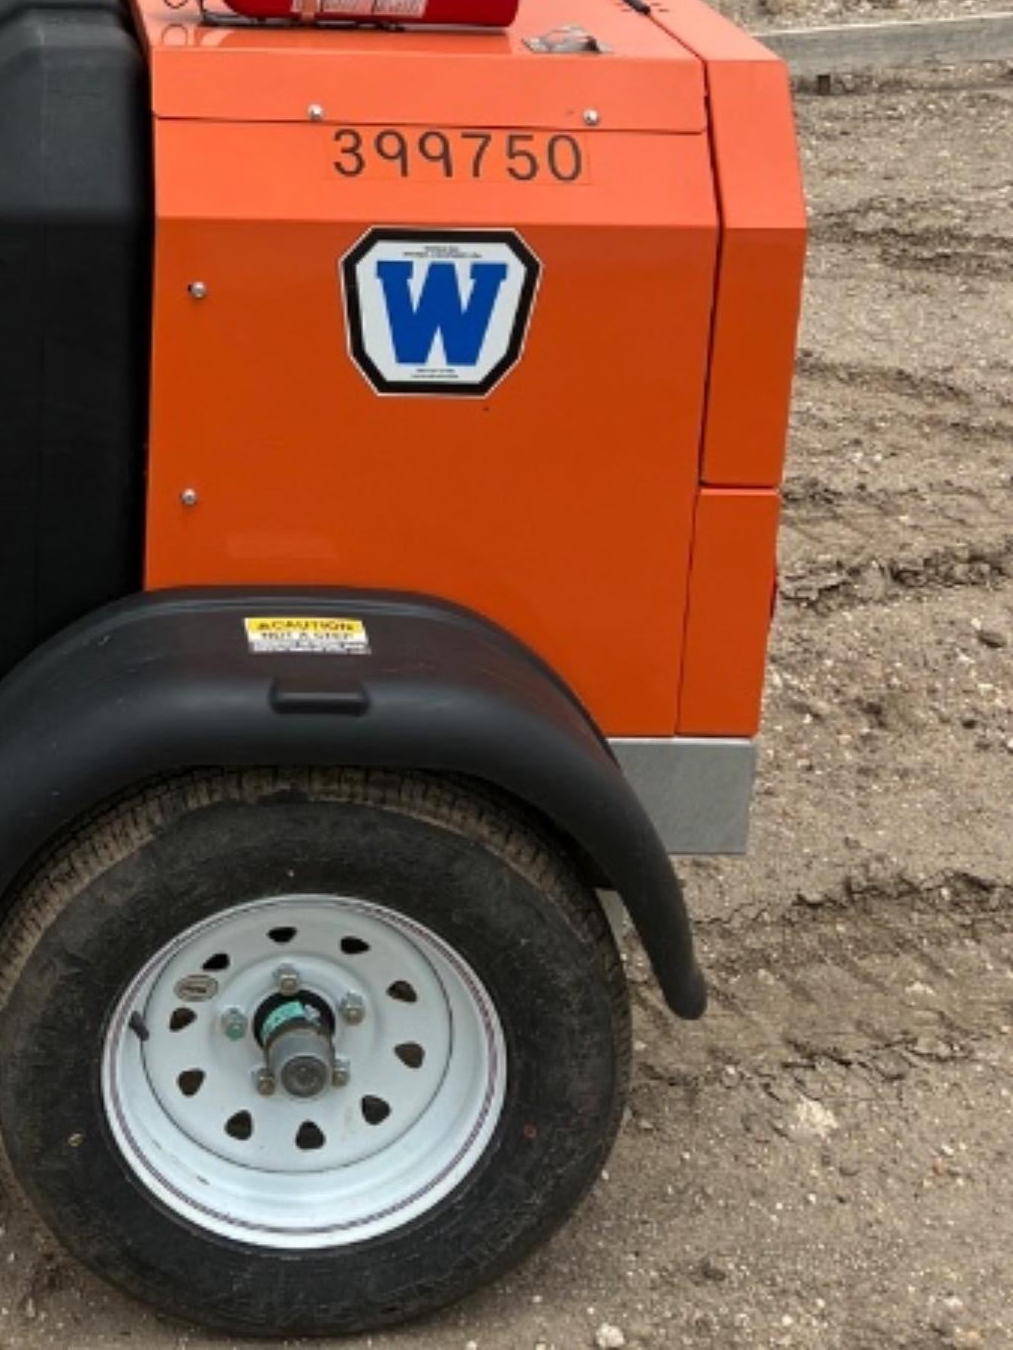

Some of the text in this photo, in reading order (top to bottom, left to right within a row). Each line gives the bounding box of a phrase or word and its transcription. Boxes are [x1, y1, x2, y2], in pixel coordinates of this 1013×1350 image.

[332, 127, 584, 182] 399750
[375, 259, 509, 368] W
[270, 619, 355, 631] CAUTION
